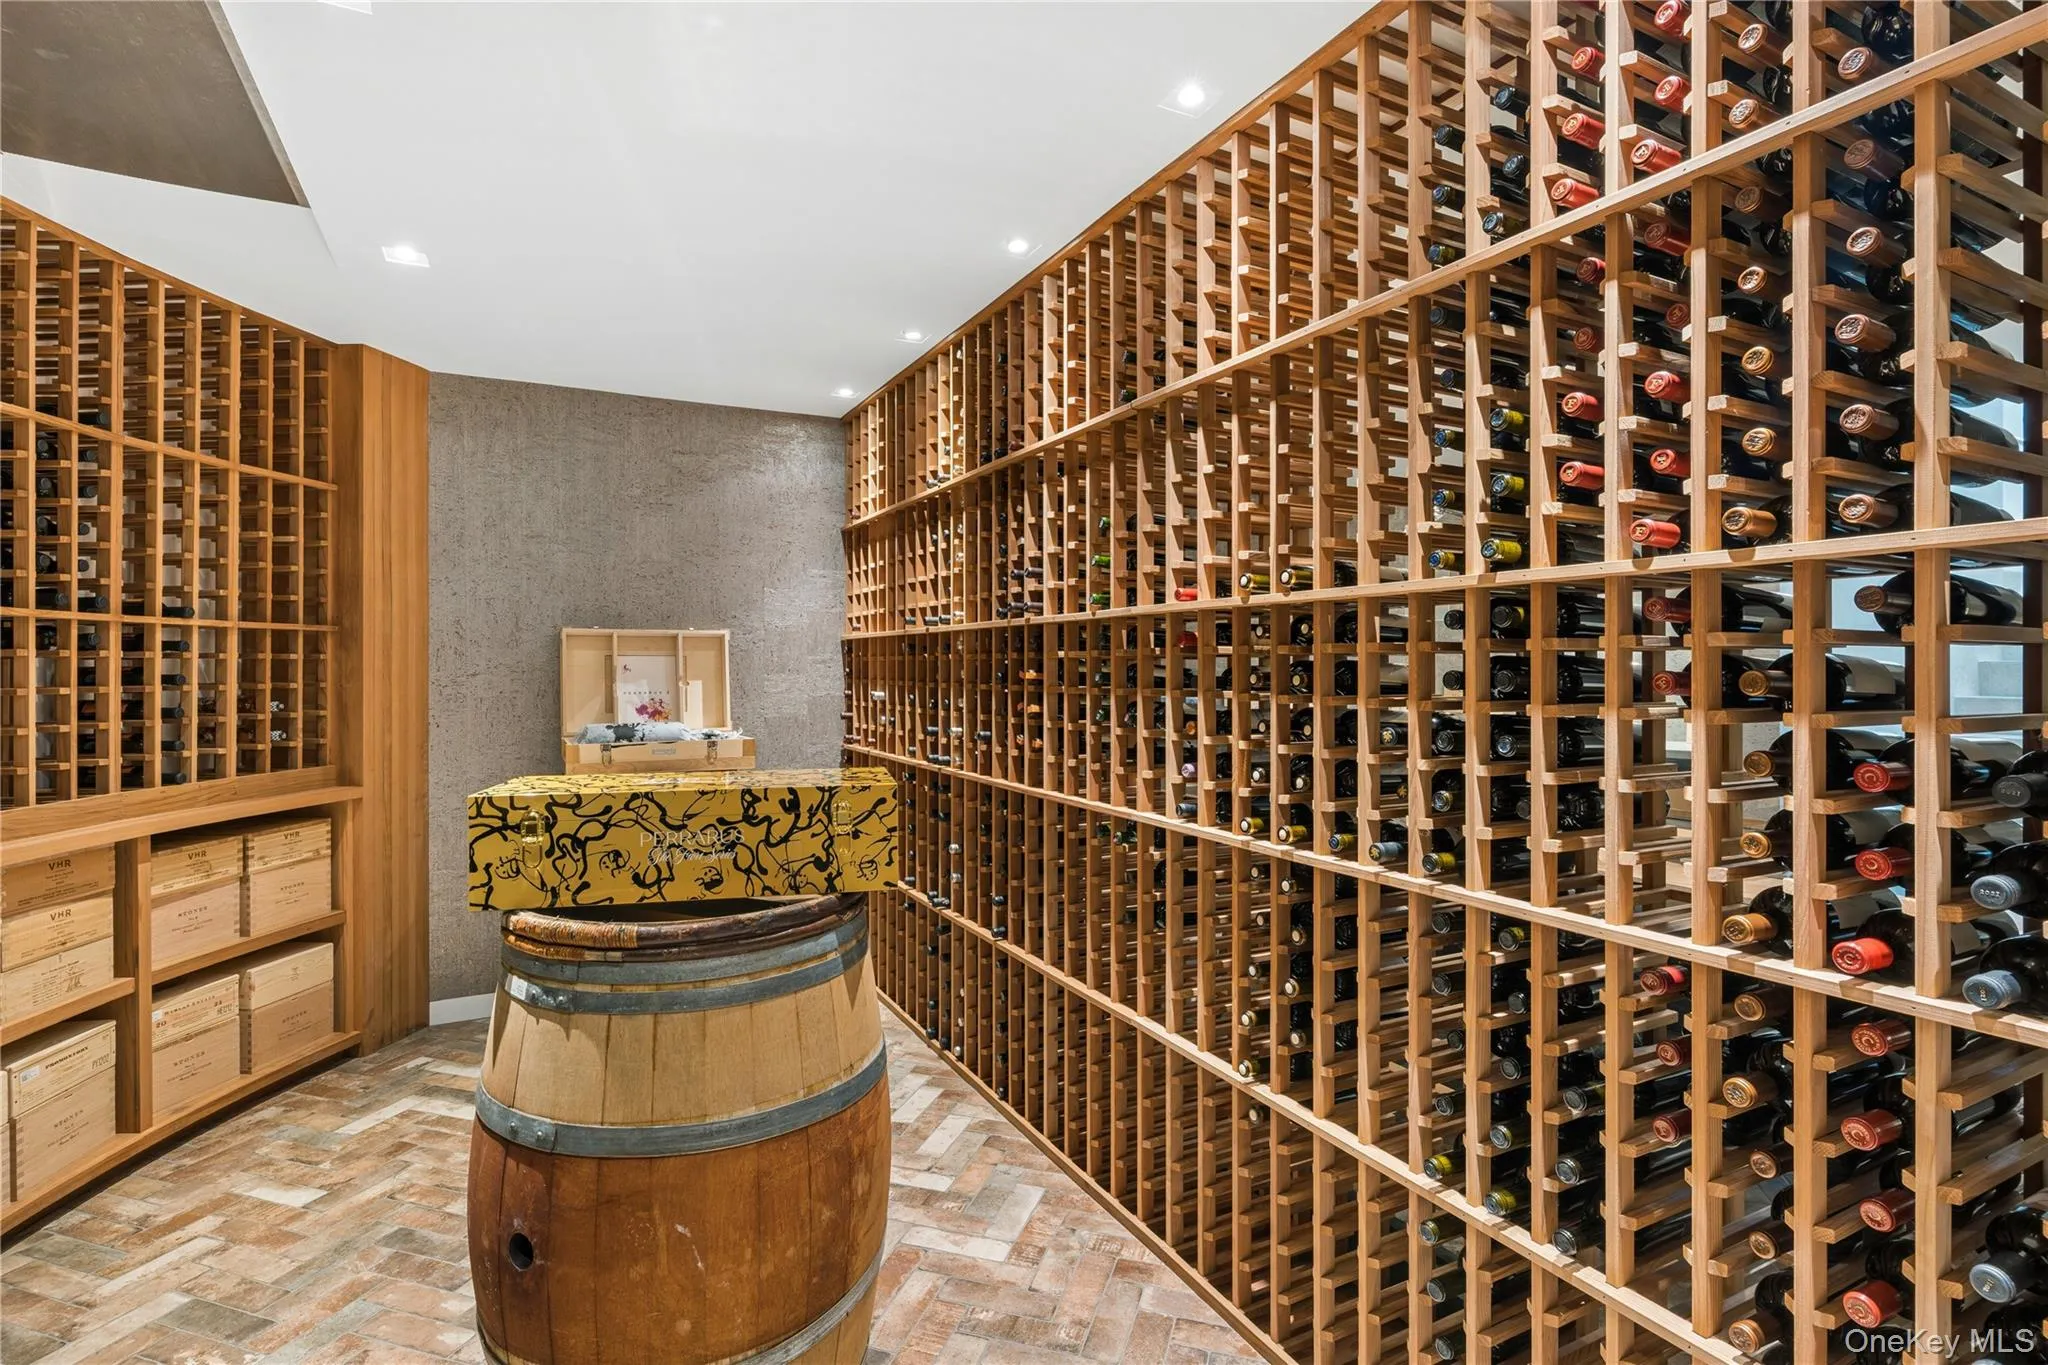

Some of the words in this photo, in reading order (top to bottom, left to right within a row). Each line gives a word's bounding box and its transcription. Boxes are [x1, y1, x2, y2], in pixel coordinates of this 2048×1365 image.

[283, 831, 300, 840] VHR
[187, 850, 208, 860] VHR
[48, 859, 72, 871] VHR
[49, 909, 72, 921] VHR
